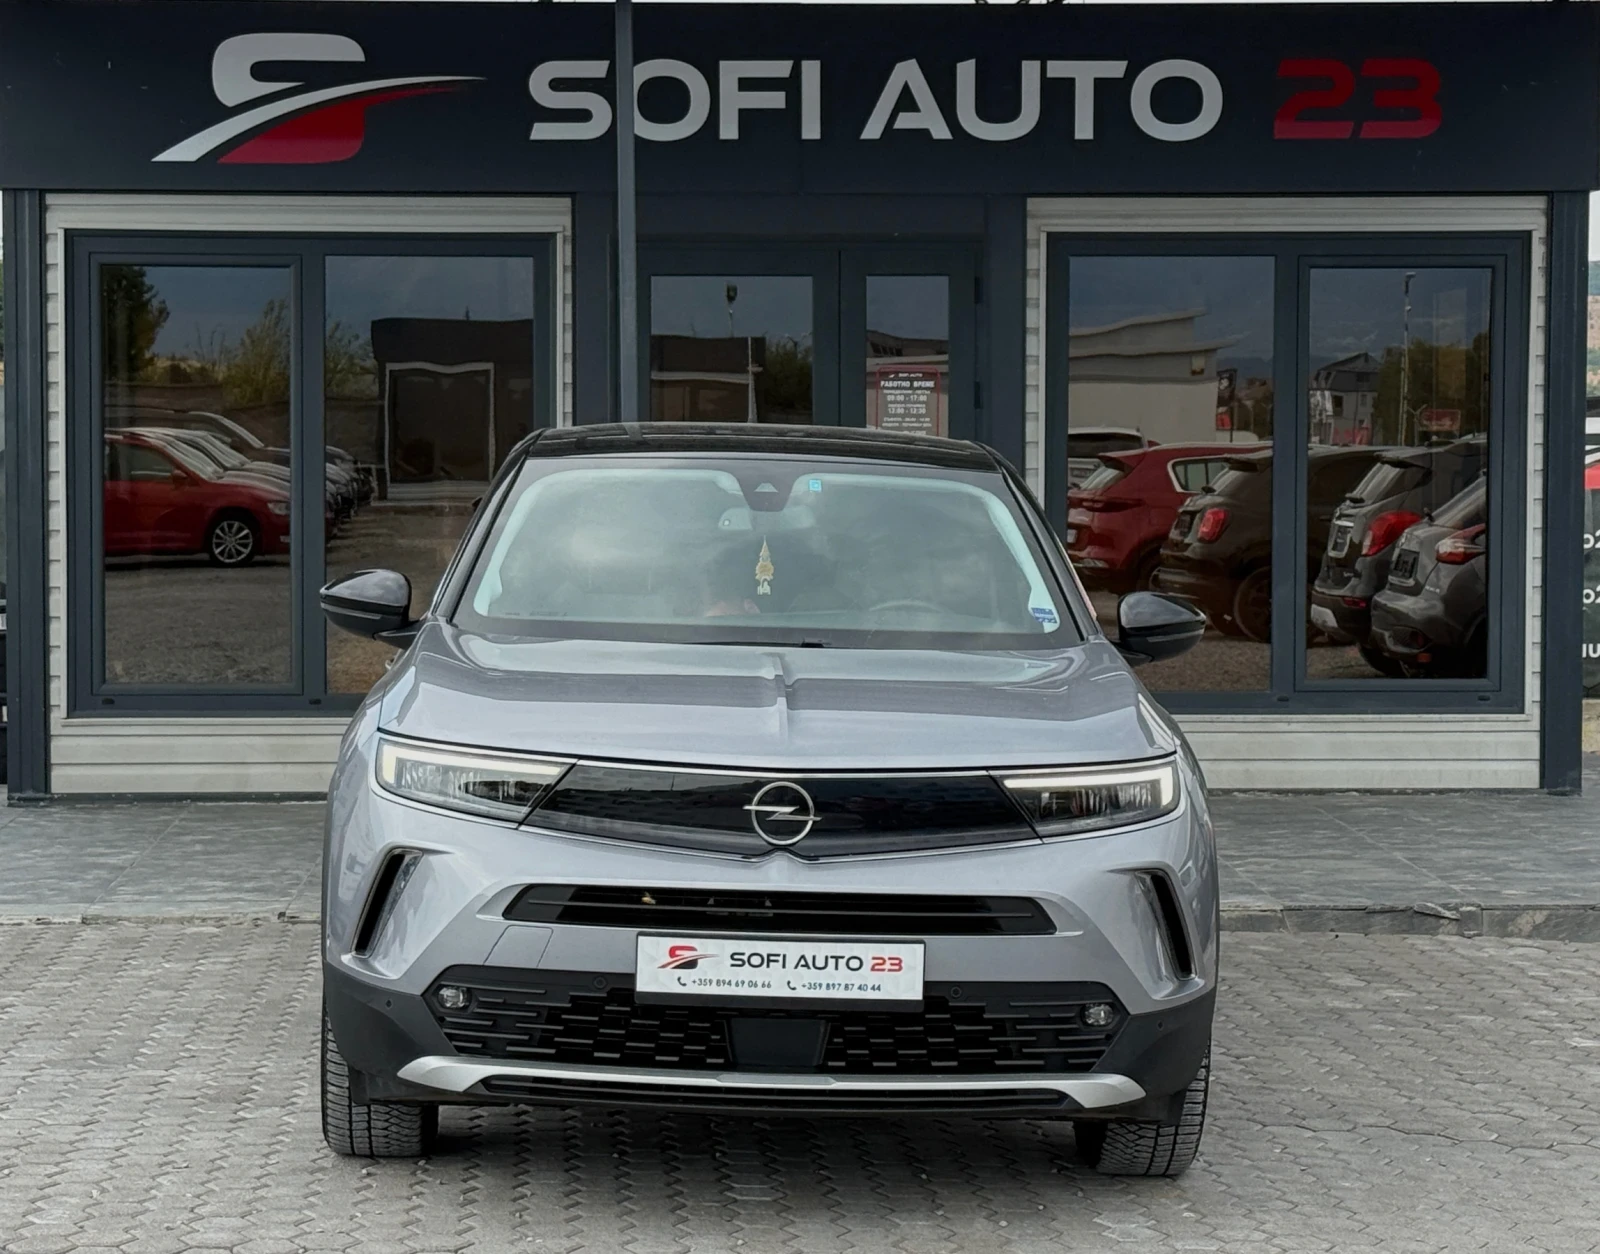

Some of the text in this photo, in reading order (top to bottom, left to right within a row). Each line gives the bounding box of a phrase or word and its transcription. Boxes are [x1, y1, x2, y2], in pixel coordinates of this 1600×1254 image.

[528, 58, 1443, 142] SOFI AUTO 23
[729, 951, 903, 973] SOFI AUTO 23
[691, 978, 772, 989] +359 894 69 06 66
[801, 982, 882, 992] +359 897 87 40 44
